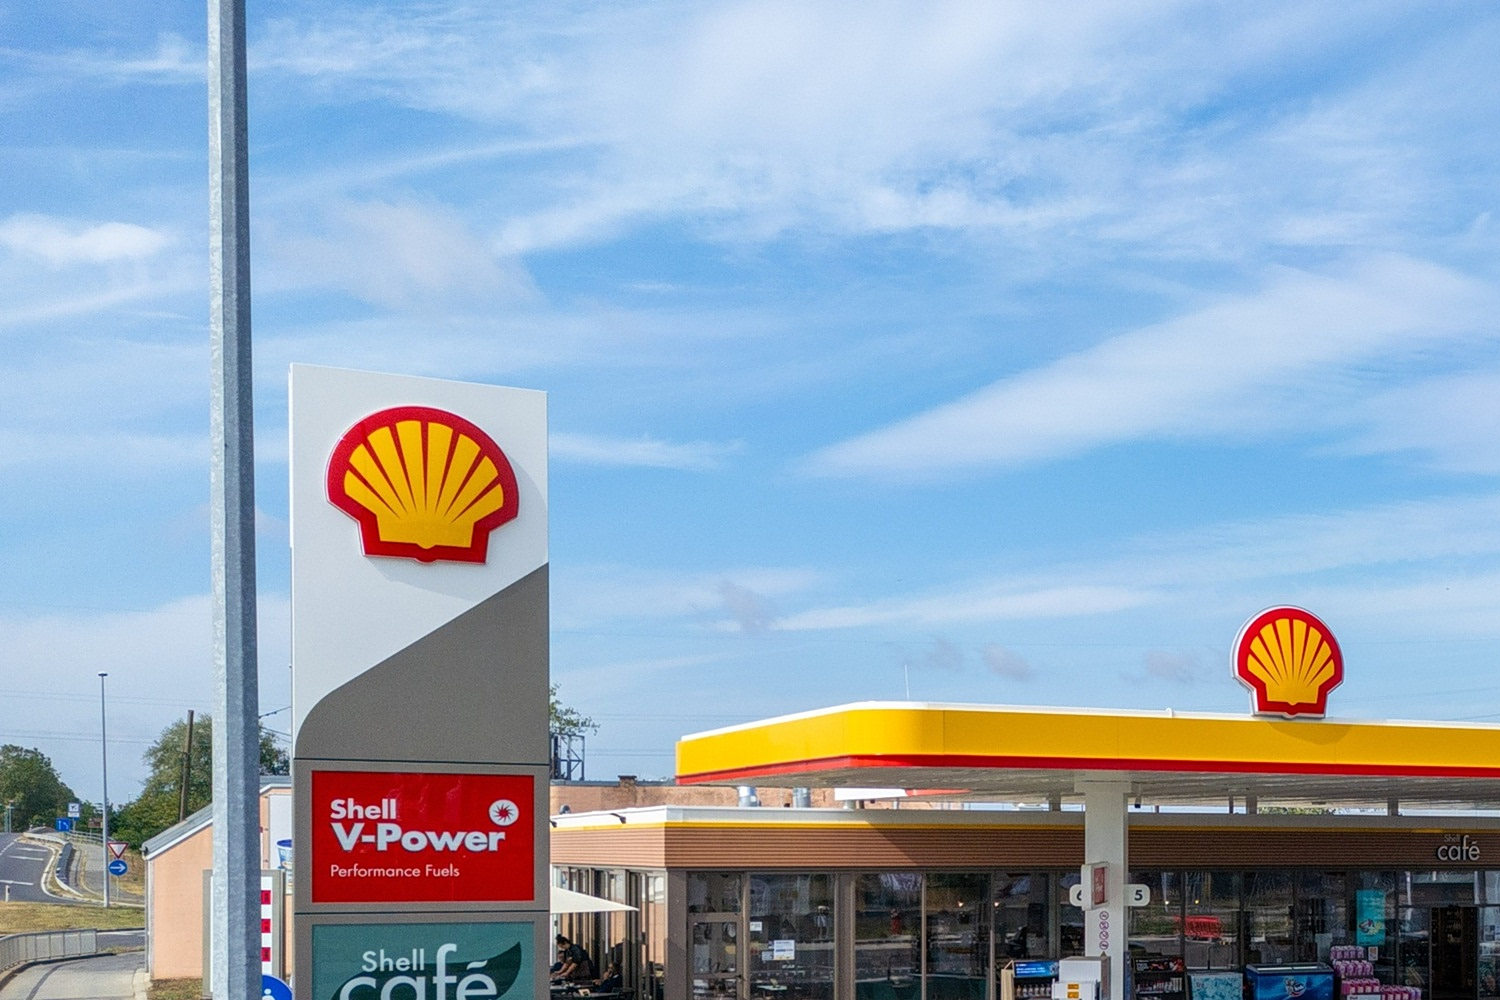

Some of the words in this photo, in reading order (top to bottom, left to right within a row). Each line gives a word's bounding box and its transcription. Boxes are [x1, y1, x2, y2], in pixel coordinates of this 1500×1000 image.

[330, 798, 397, 820] Shell
[330, 822, 506, 852] V-Power
[330, 864, 421, 878] Performance
[425, 863, 460, 878] Fuels
[1134, 889, 1143, 901] 5
[361, 948, 425, 973] Shell
